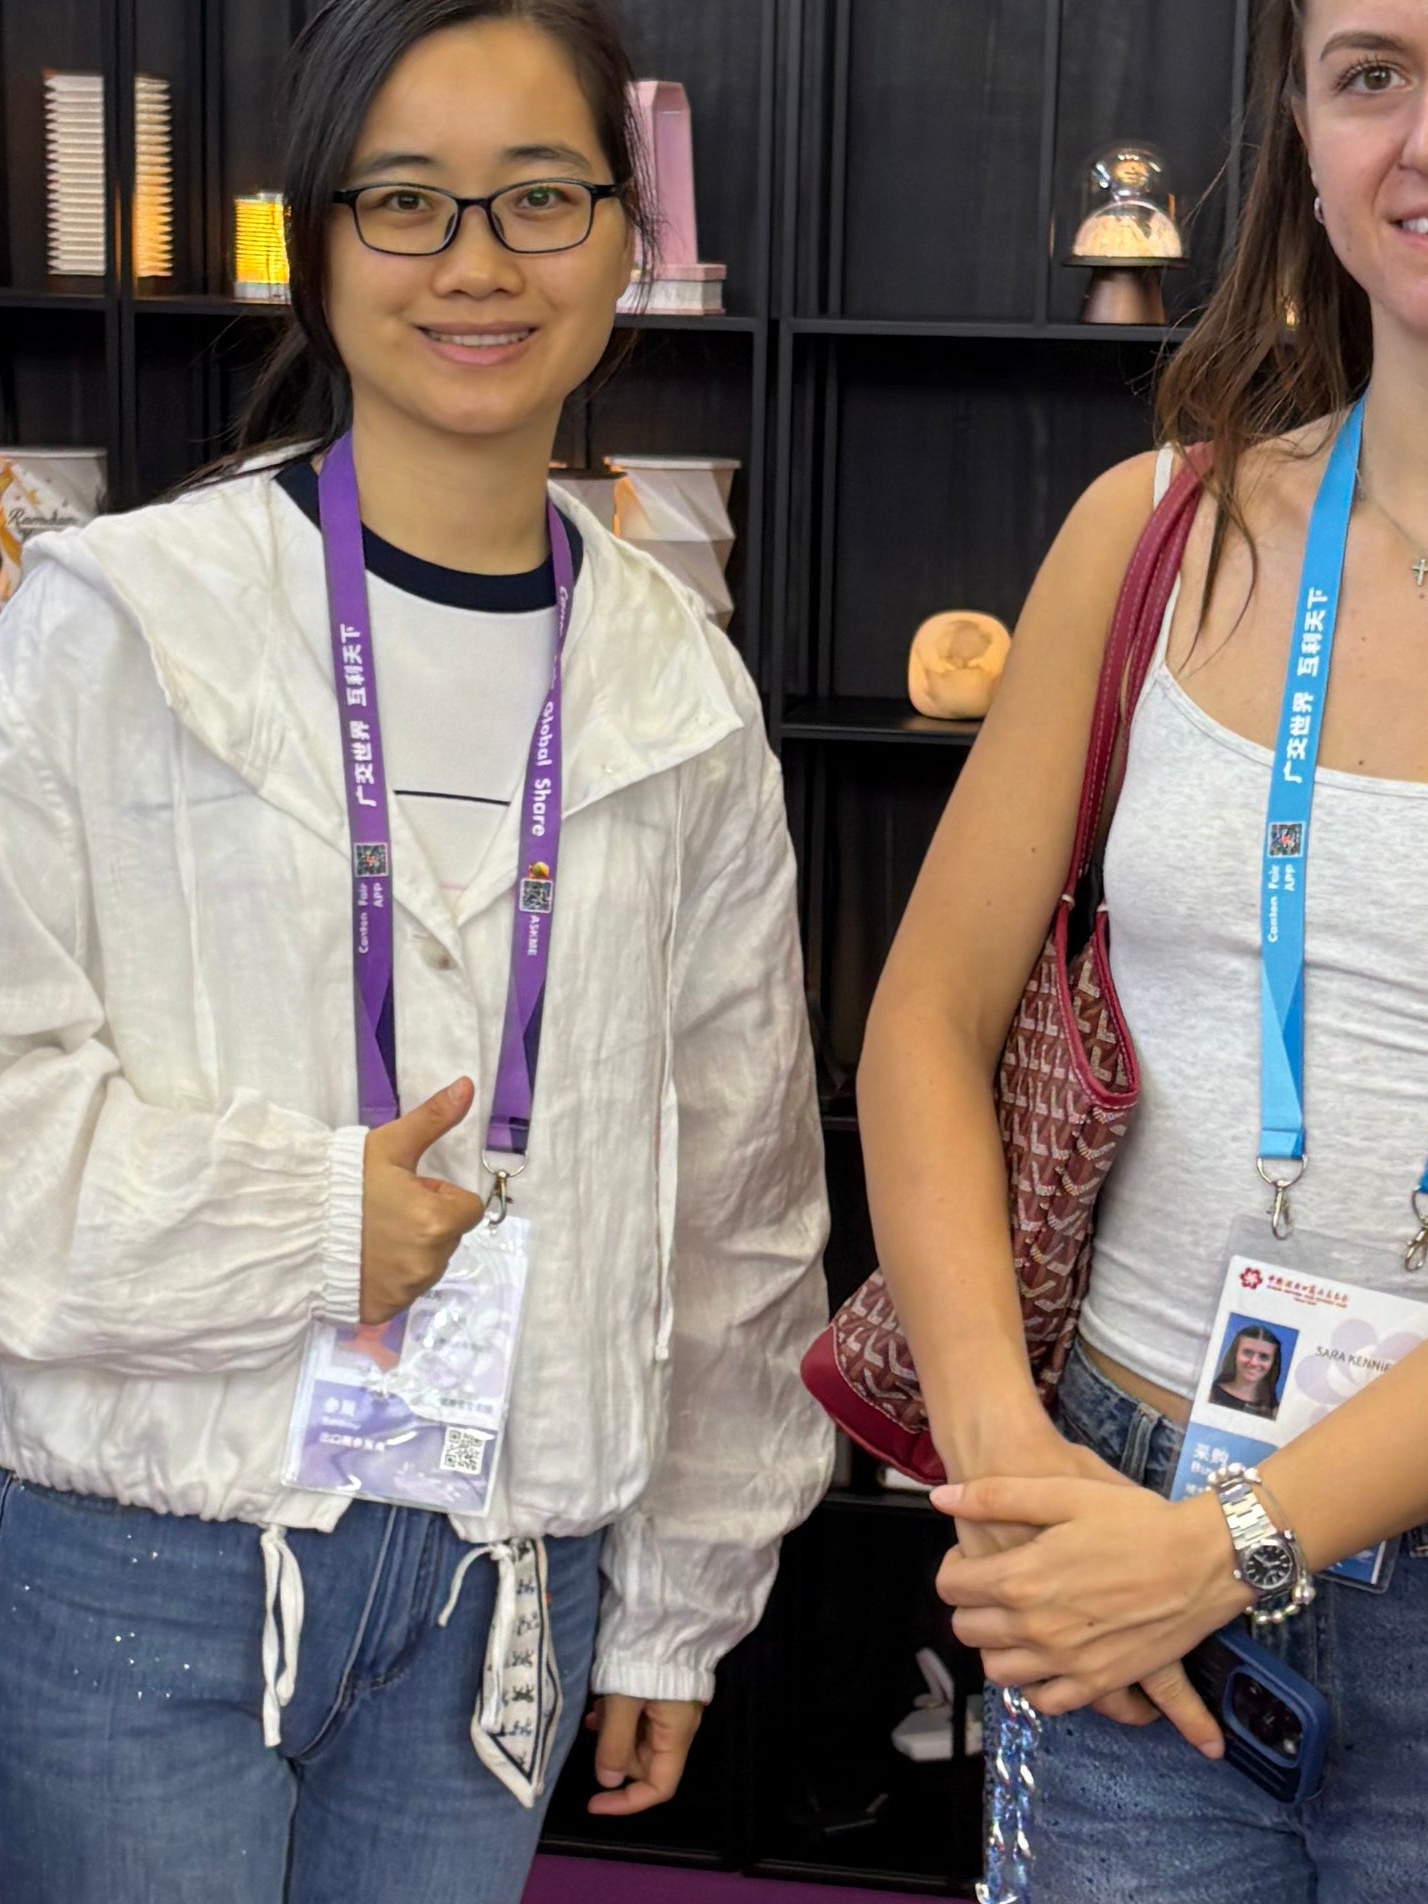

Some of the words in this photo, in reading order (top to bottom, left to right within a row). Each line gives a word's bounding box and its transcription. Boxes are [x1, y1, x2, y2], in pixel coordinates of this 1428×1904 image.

[1297, 587, 1328, 677] 互利天下
[340, 623, 367, 707] 互利天下
[535, 700, 554, 766] Global
[1283, 691, 1314, 783] 广交世界
[350, 720, 376, 807] 广交世界
[532, 777, 552, 838] Share
[358, 882, 368, 907] Fair
[373, 882, 384, 908] APP
[1268, 864, 1280, 890] Fair
[1284, 864, 1296, 891] APP
[358, 912, 369, 954] Canton
[527, 914, 540, 956] ASKME
[1268, 897, 1278, 943] Canton
[1315, 1346, 1346, 1362] SARA
